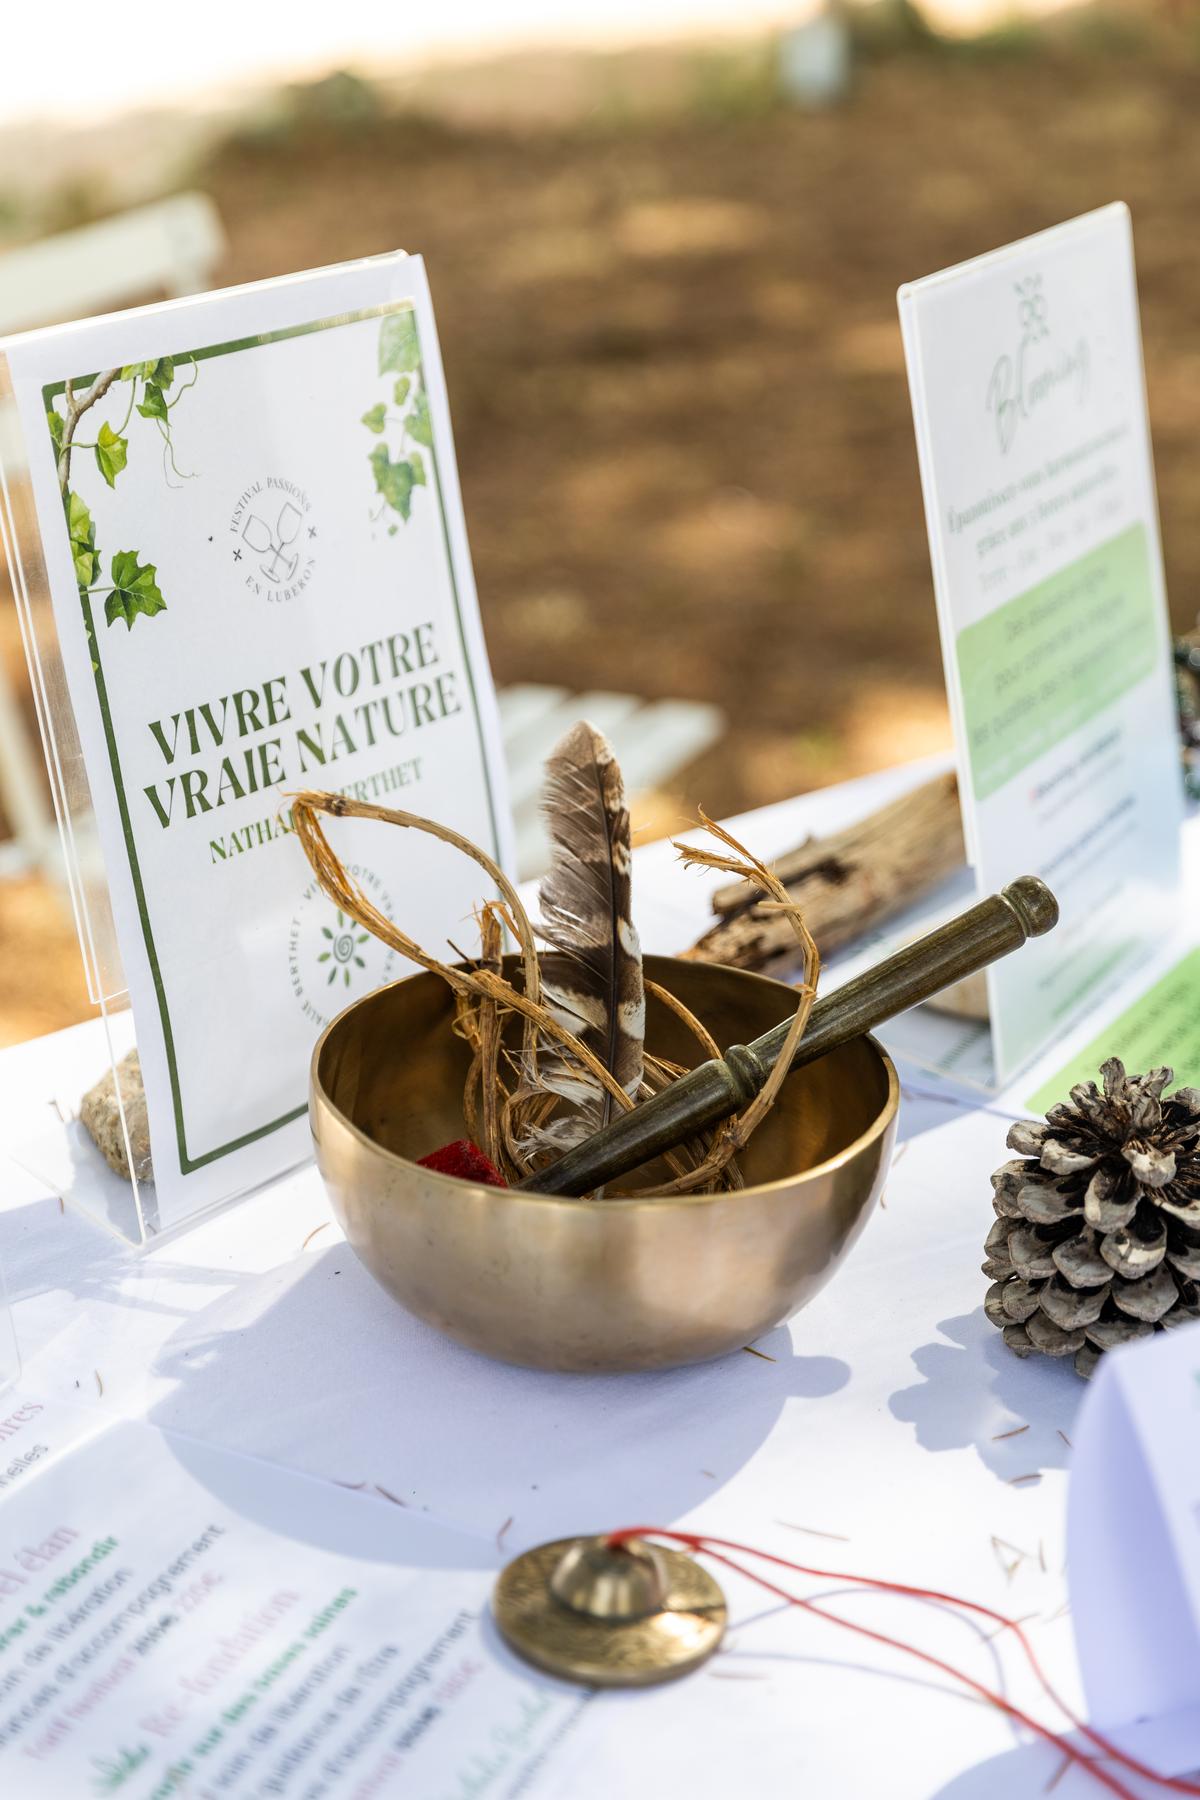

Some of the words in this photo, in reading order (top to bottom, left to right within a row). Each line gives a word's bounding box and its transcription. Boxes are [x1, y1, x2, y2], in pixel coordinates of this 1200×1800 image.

[230, 481, 263, 533] FESTIVAL
[267, 476, 312, 513] PASSIONS
[245, 575, 261, 596] EN
[267, 558, 316, 602] LUBERON
[148, 676, 291, 765] VIVRE
[300, 621, 439, 709] VOTRE
[143, 738, 286, 829] VRAIE
[296, 671, 462, 773] NATURE
[209, 807, 298, 864] NATHA
[339, 757, 421, 801] ERTHET
[289, 917, 303, 998] BERTHET
